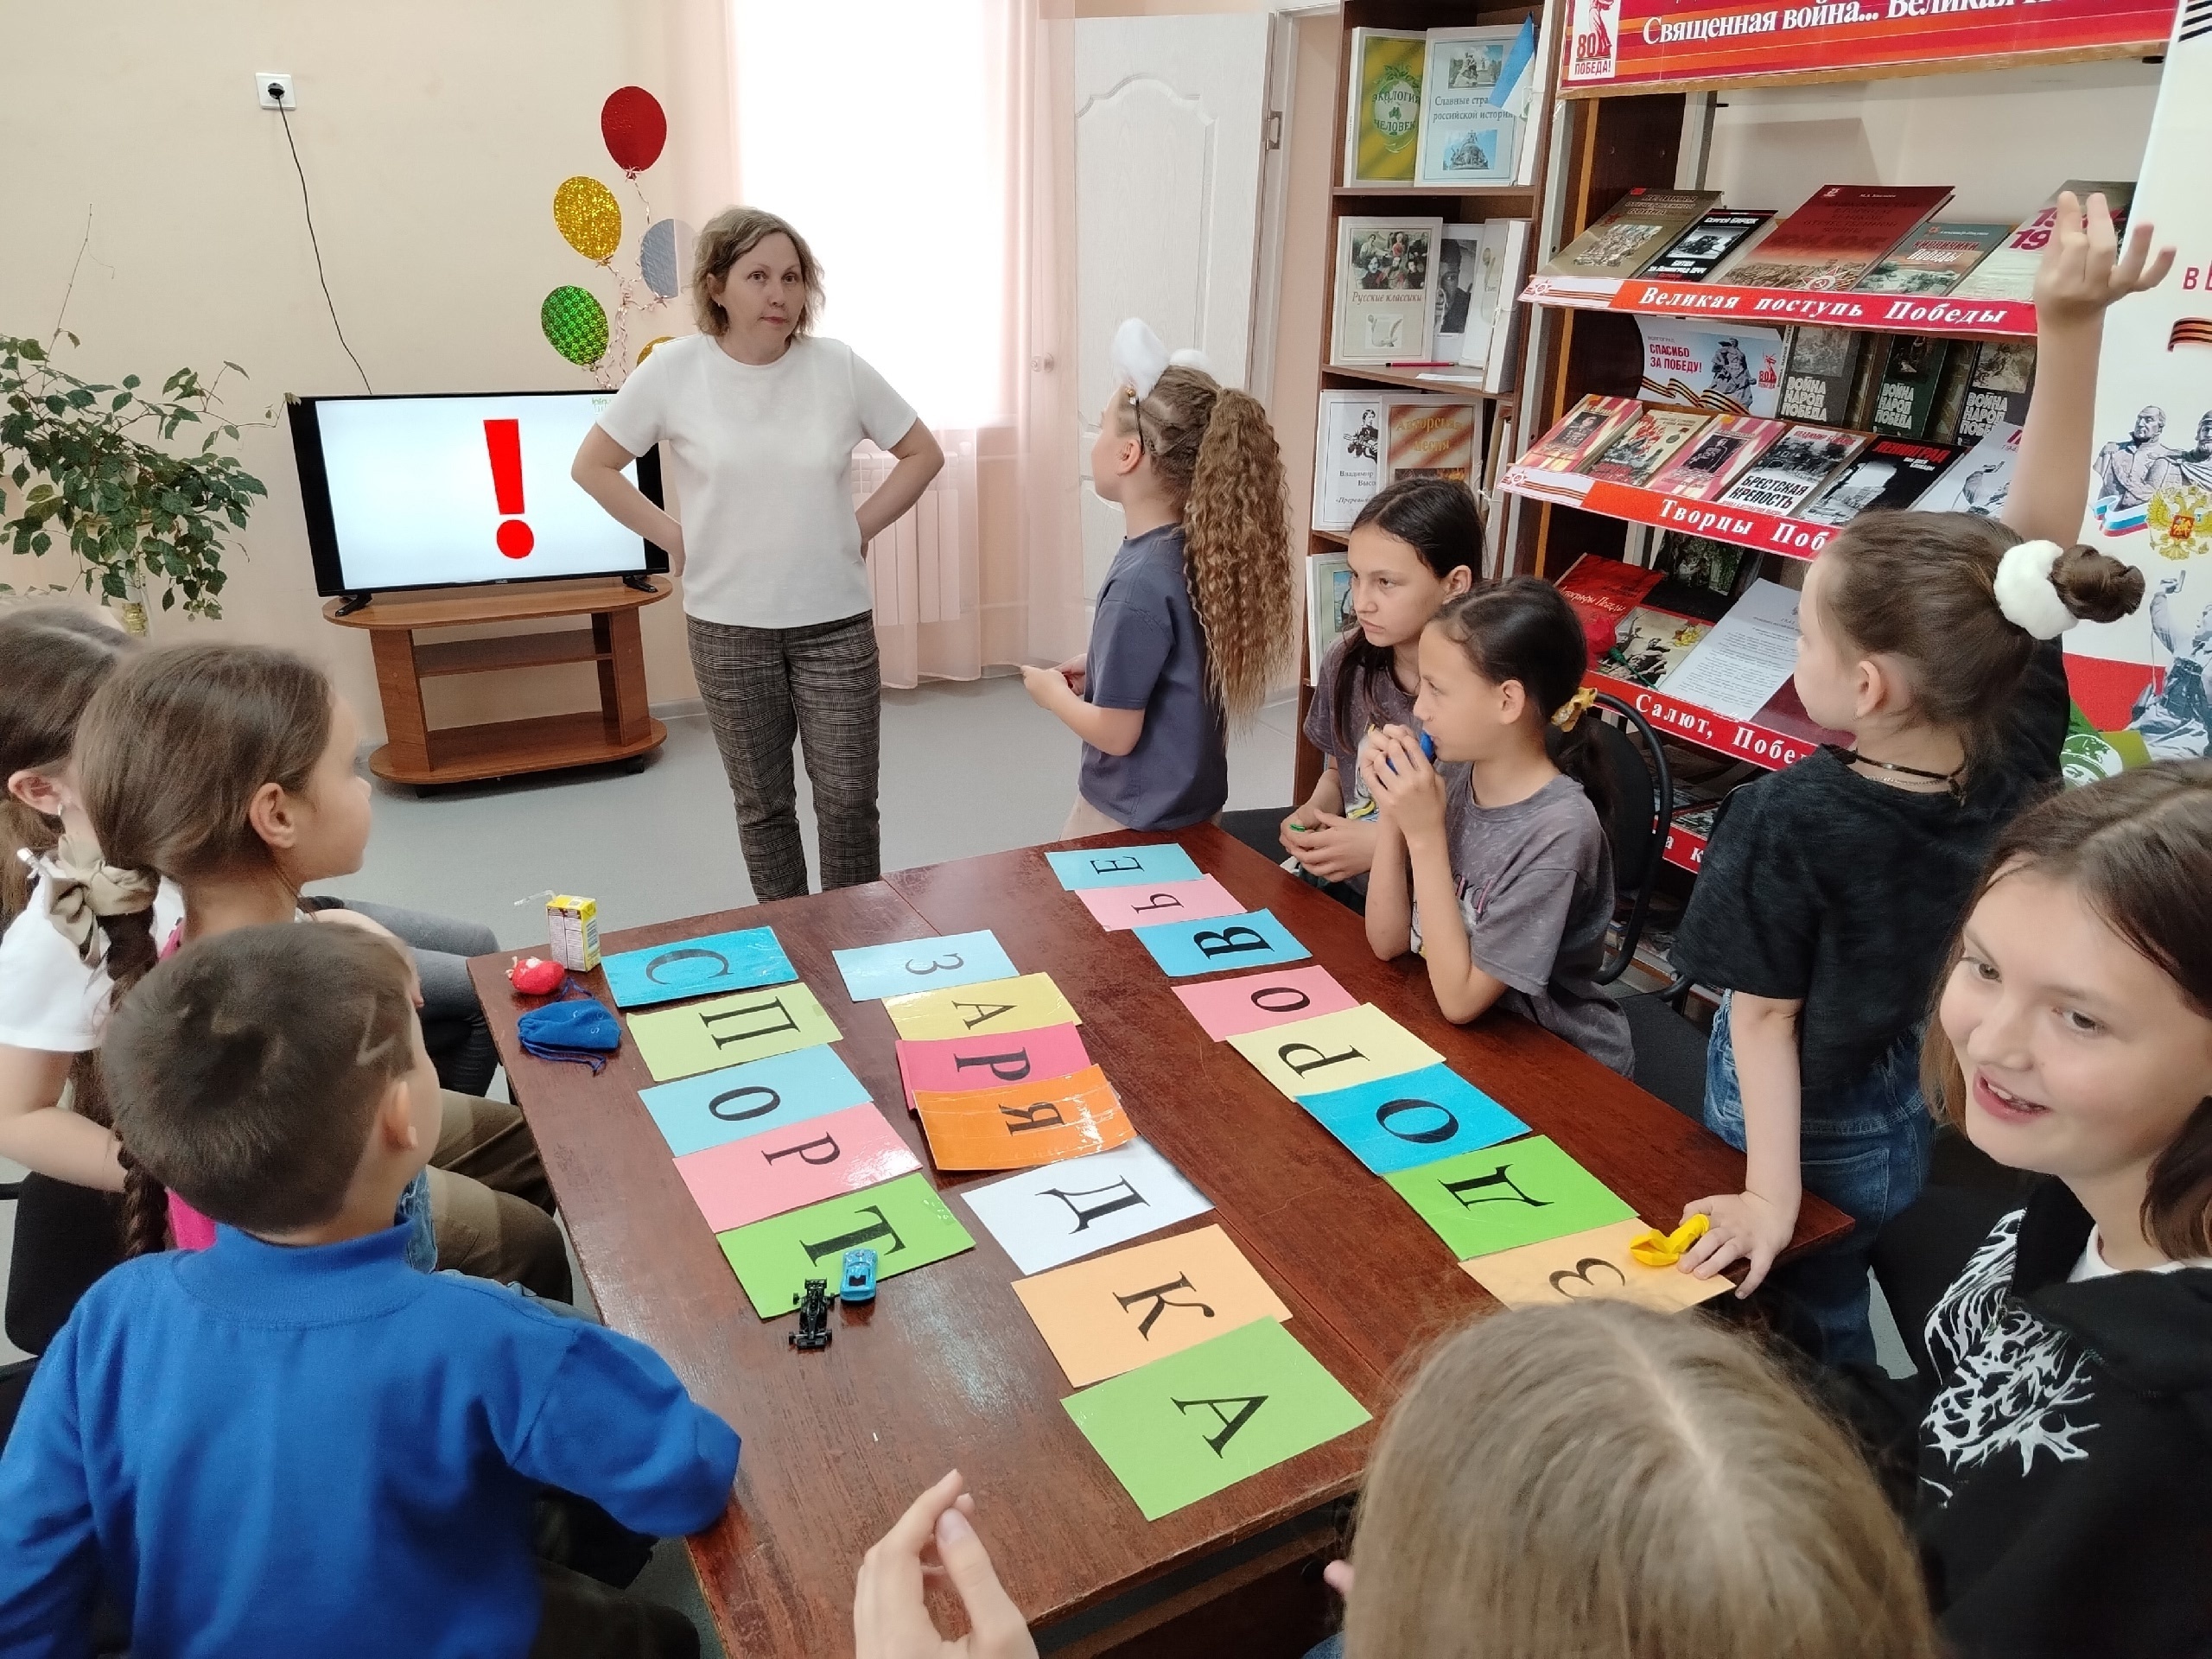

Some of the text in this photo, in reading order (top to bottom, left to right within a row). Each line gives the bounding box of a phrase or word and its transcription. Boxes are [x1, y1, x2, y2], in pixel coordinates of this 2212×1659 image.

[1643, 10, 1778, 44] Священная
[1574, 60, 1611, 75] ПОБЕДА!
[1372, 91, 1421, 104] ЭКОЛОГИЯ
[1435, 96, 1489, 107] Славные стра
[1374, 120, 1415, 131] ЧЕЛОВЕК
[1433, 111, 1478, 123] российской
[1352, 291, 1422, 305] Русские классики
[1639, 286, 2009, 325] Великая поступь Победы
[1649, 344, 1690, 357] СПАСИБО
[1650, 357, 1702, 373] ЗА ПОБЕДУ!
[1787, 376, 1826, 395] ВОЙНА
[1882, 383, 1914, 401] ВОЙНА
[1784, 391, 1825, 406] НАРОД
[1878, 397, 1911, 415] НАРОД
[1967, 391, 2007, 411] ВОЙНА
[1781, 403, 1827, 422] ПОБЕДА
[1875, 410, 1912, 429] ПОБЕДА
[1962, 406, 2005, 424] НАРОД
[1960, 420, 1993, 436] ПОБЕ
[1872, 442, 1951, 463] ЛЕНИНГРАД
[1741, 475, 1809, 496] БРЕСТСКАЯ
[1728, 486, 1794, 509] КРЕПОСТЬ
[1660, 499, 1753, 535] Творцы
[1770, 522, 1831, 550] Поб
[1636, 694, 1810, 765] Салют, Побе
